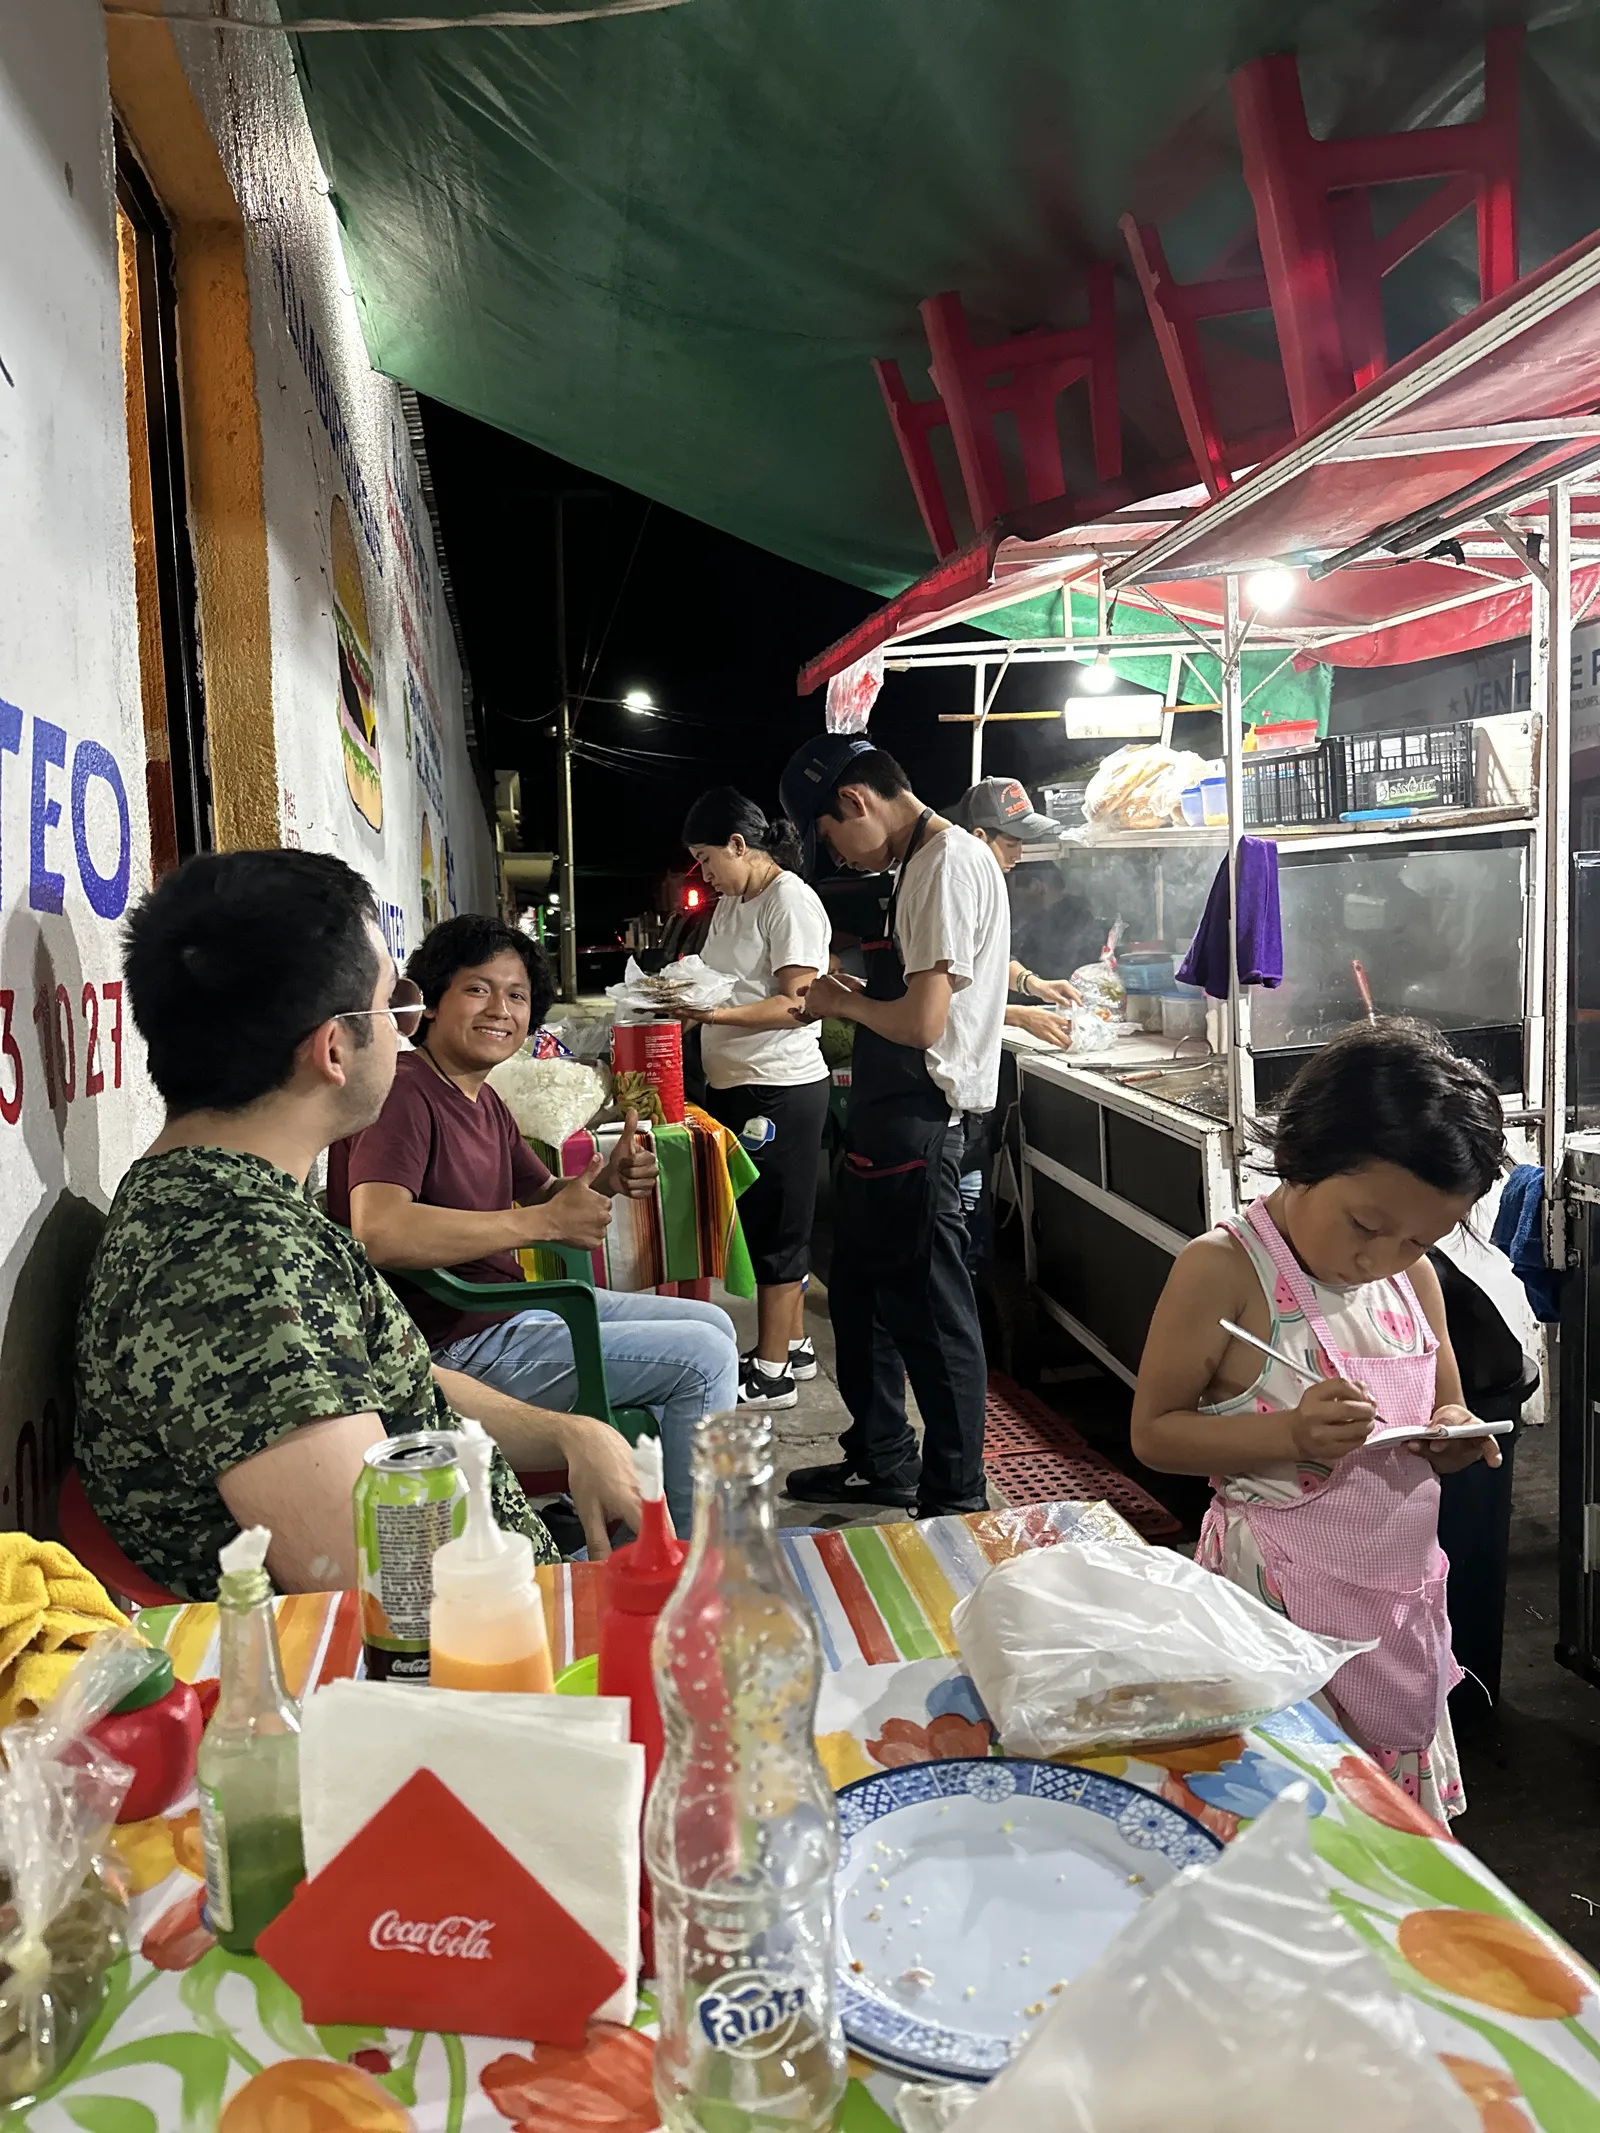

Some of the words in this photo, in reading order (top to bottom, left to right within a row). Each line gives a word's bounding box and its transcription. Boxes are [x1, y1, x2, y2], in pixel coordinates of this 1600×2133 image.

[1462, 670, 1531, 718] VENT
[368, 1908, 497, 1960] Coca-Cola
[698, 1987, 806, 2048] Fanta
